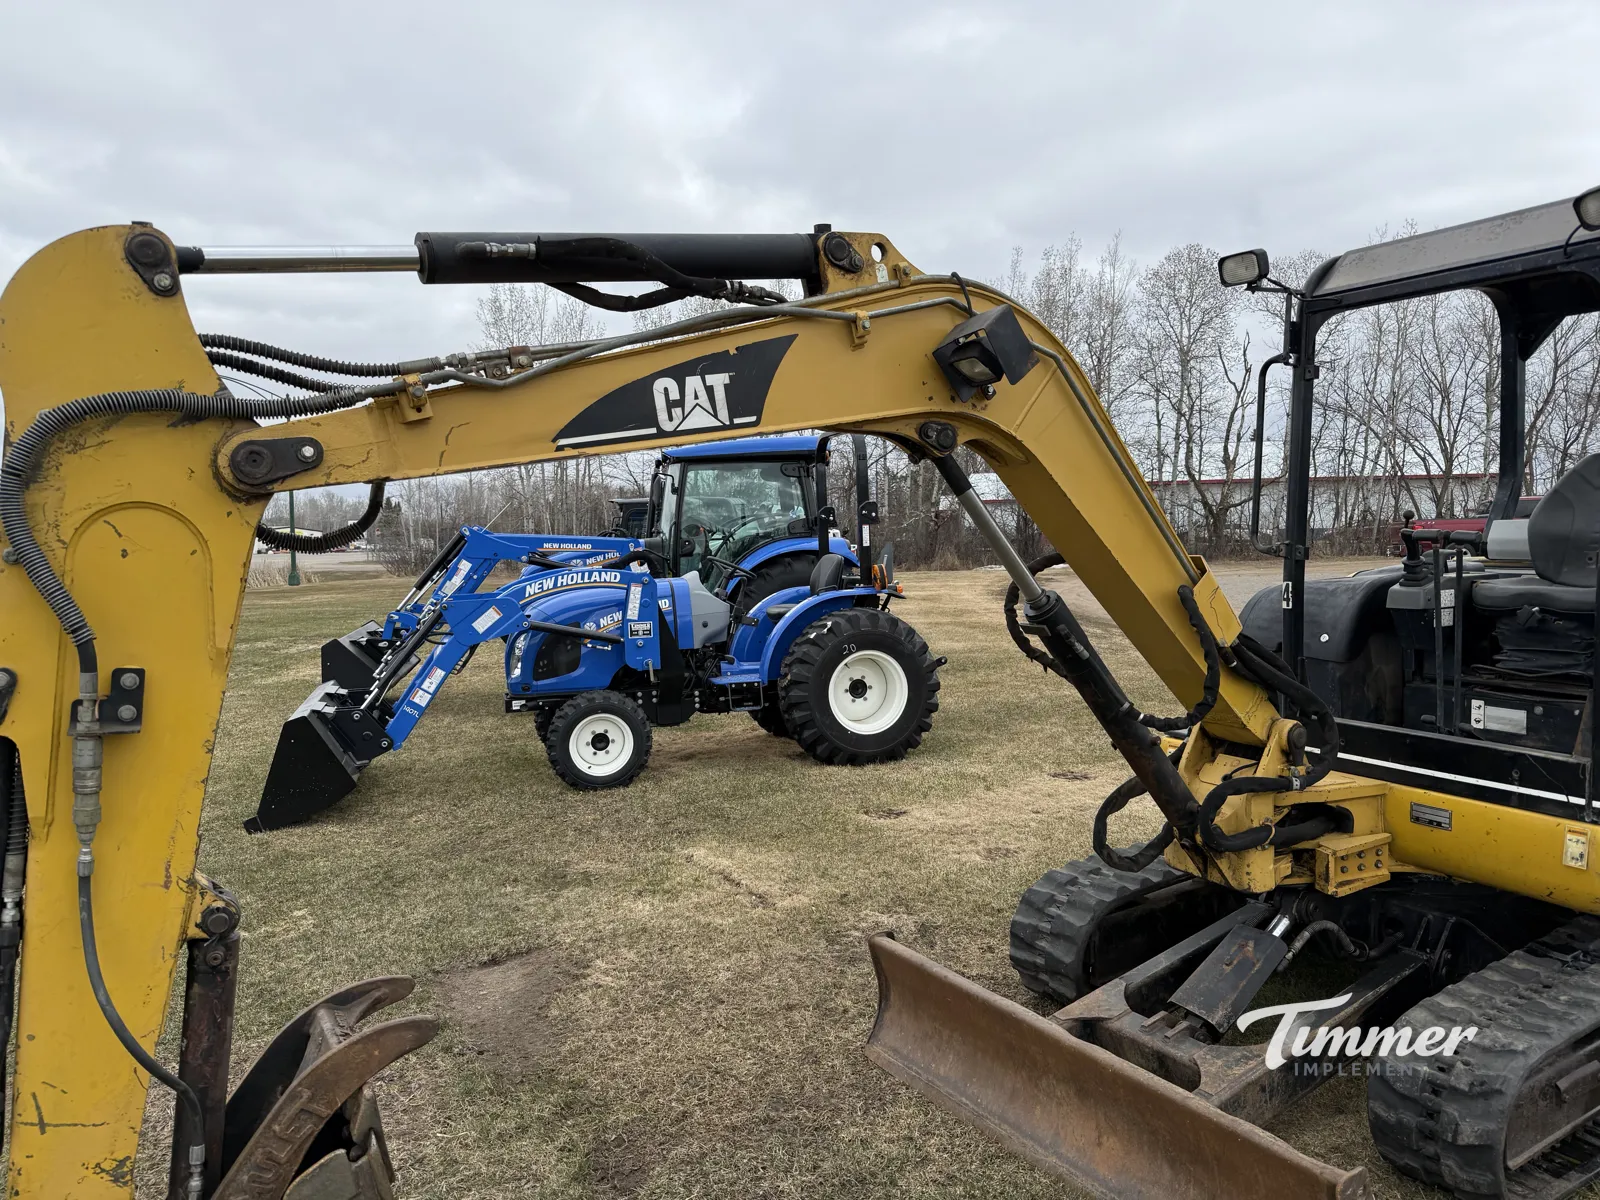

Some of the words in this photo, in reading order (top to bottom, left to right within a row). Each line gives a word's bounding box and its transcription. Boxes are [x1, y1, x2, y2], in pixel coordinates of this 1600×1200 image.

[653, 373, 730, 431] CAT
[586, 554, 604, 566] NEW
[525, 576, 555, 598] NEW
[557, 571, 621, 587] HOLLAND
[600, 610, 623, 628] NEW
[842, 643, 857, 655] 20
